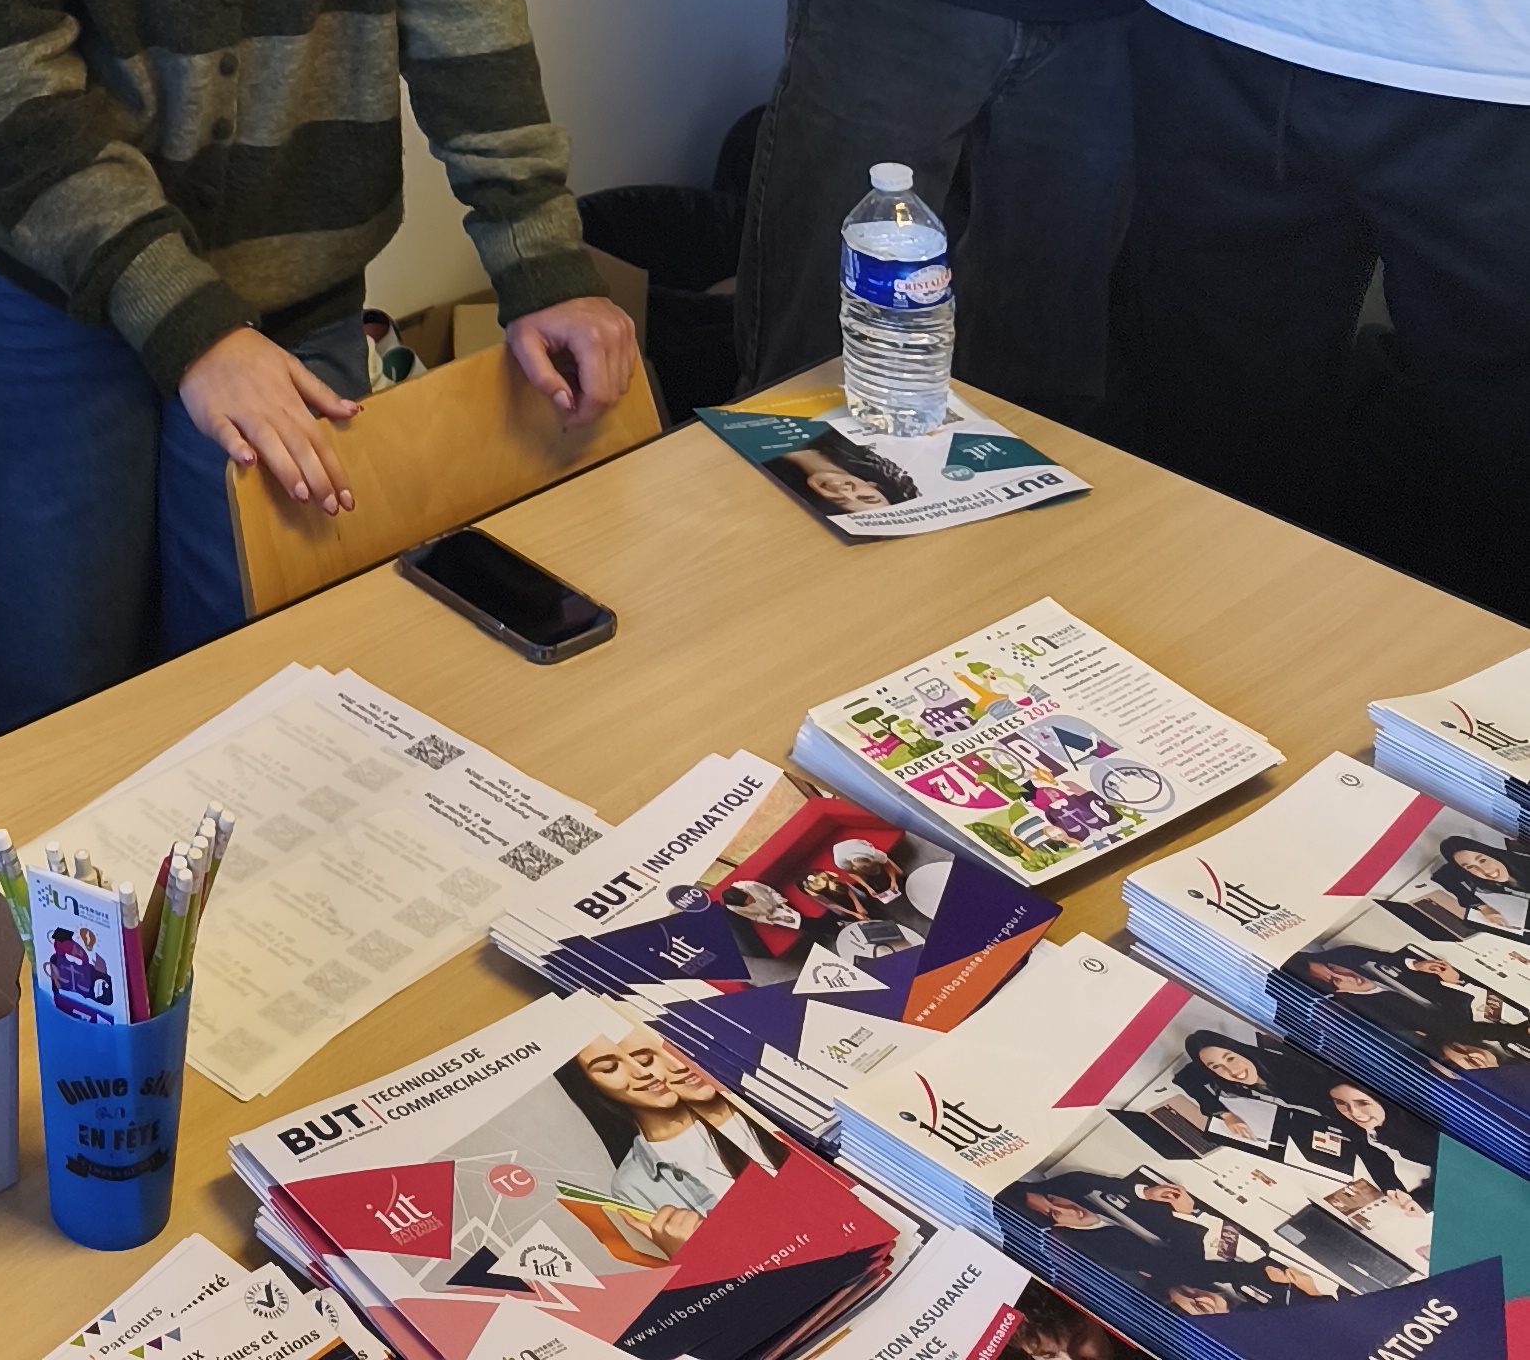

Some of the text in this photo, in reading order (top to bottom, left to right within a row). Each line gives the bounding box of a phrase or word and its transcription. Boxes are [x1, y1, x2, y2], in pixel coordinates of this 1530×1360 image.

[894, 698, 1061, 781] PORTES OUVERTES 2026
[642, 775, 764, 874] INFORMATIQUE
[675, 888, 703, 909] INFO
[368, 1059, 463, 1106] TECHNIQUES
[461, 1047, 485, 1066] DE
[387, 1041, 542, 1121] COMMERCIALISATION
[960, 1130, 1021, 1162] BAYONNE
[972, 1137, 1030, 1168] PAYS BASQUE
[493, 1169, 531, 1192] TC
[623, 1231, 812, 1348] www.iutbayonne.univ-pau.fr
[908, 1263, 983, 1340] ASSURANCE
[99, 1304, 163, 1356] Parcours
[261, 1329, 279, 1346] et
